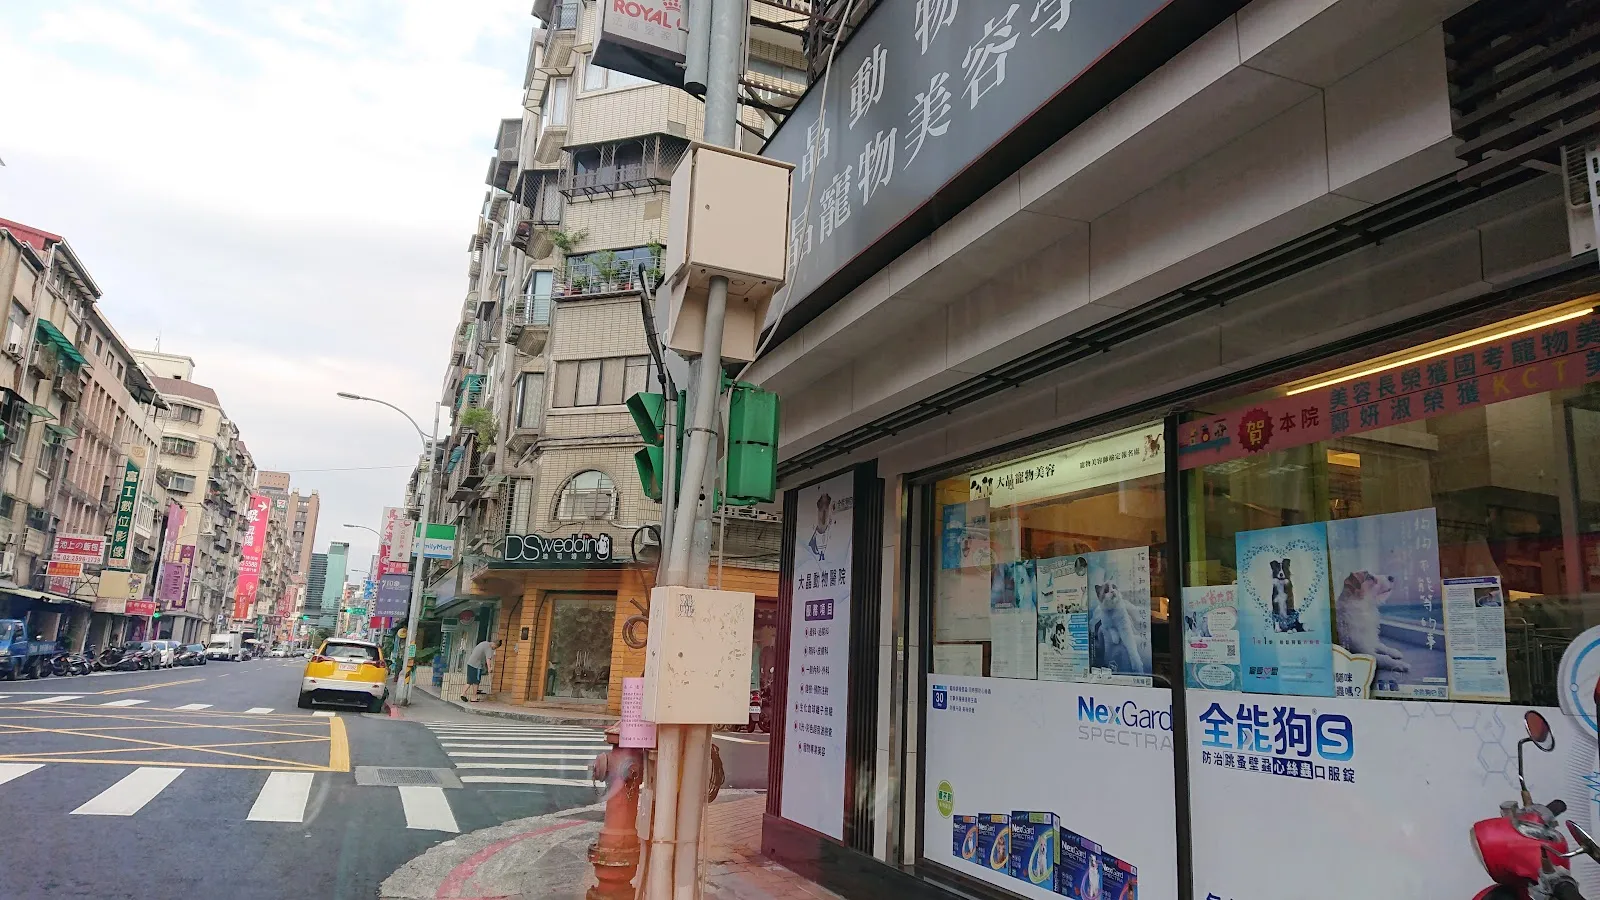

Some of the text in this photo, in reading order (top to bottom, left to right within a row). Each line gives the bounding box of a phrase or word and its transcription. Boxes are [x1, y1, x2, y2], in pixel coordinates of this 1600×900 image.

[613, 0, 672, 29] ROYAL
[1279, 406, 1320, 433] 本院
[1246, 419, 1265, 446] 賀
[995, 463, 1056, 490] 大晶寵物美容
[112, 470, 139, 558] 富士數位影像
[59, 539, 99, 552] 池上の飯包
[415, 541, 452, 551] FmilyMart
[798, 567, 846, 590] 大晶動物醫院
[806, 603, 833, 617] 服務項目
[935, 692, 944, 703] 30
[1077, 696, 1173, 731] NexGard
[1077, 725, 1173, 750] SPECTRA
[1012, 823, 1035, 835] NexGard
[1061, 840, 1087, 859] NexGard
